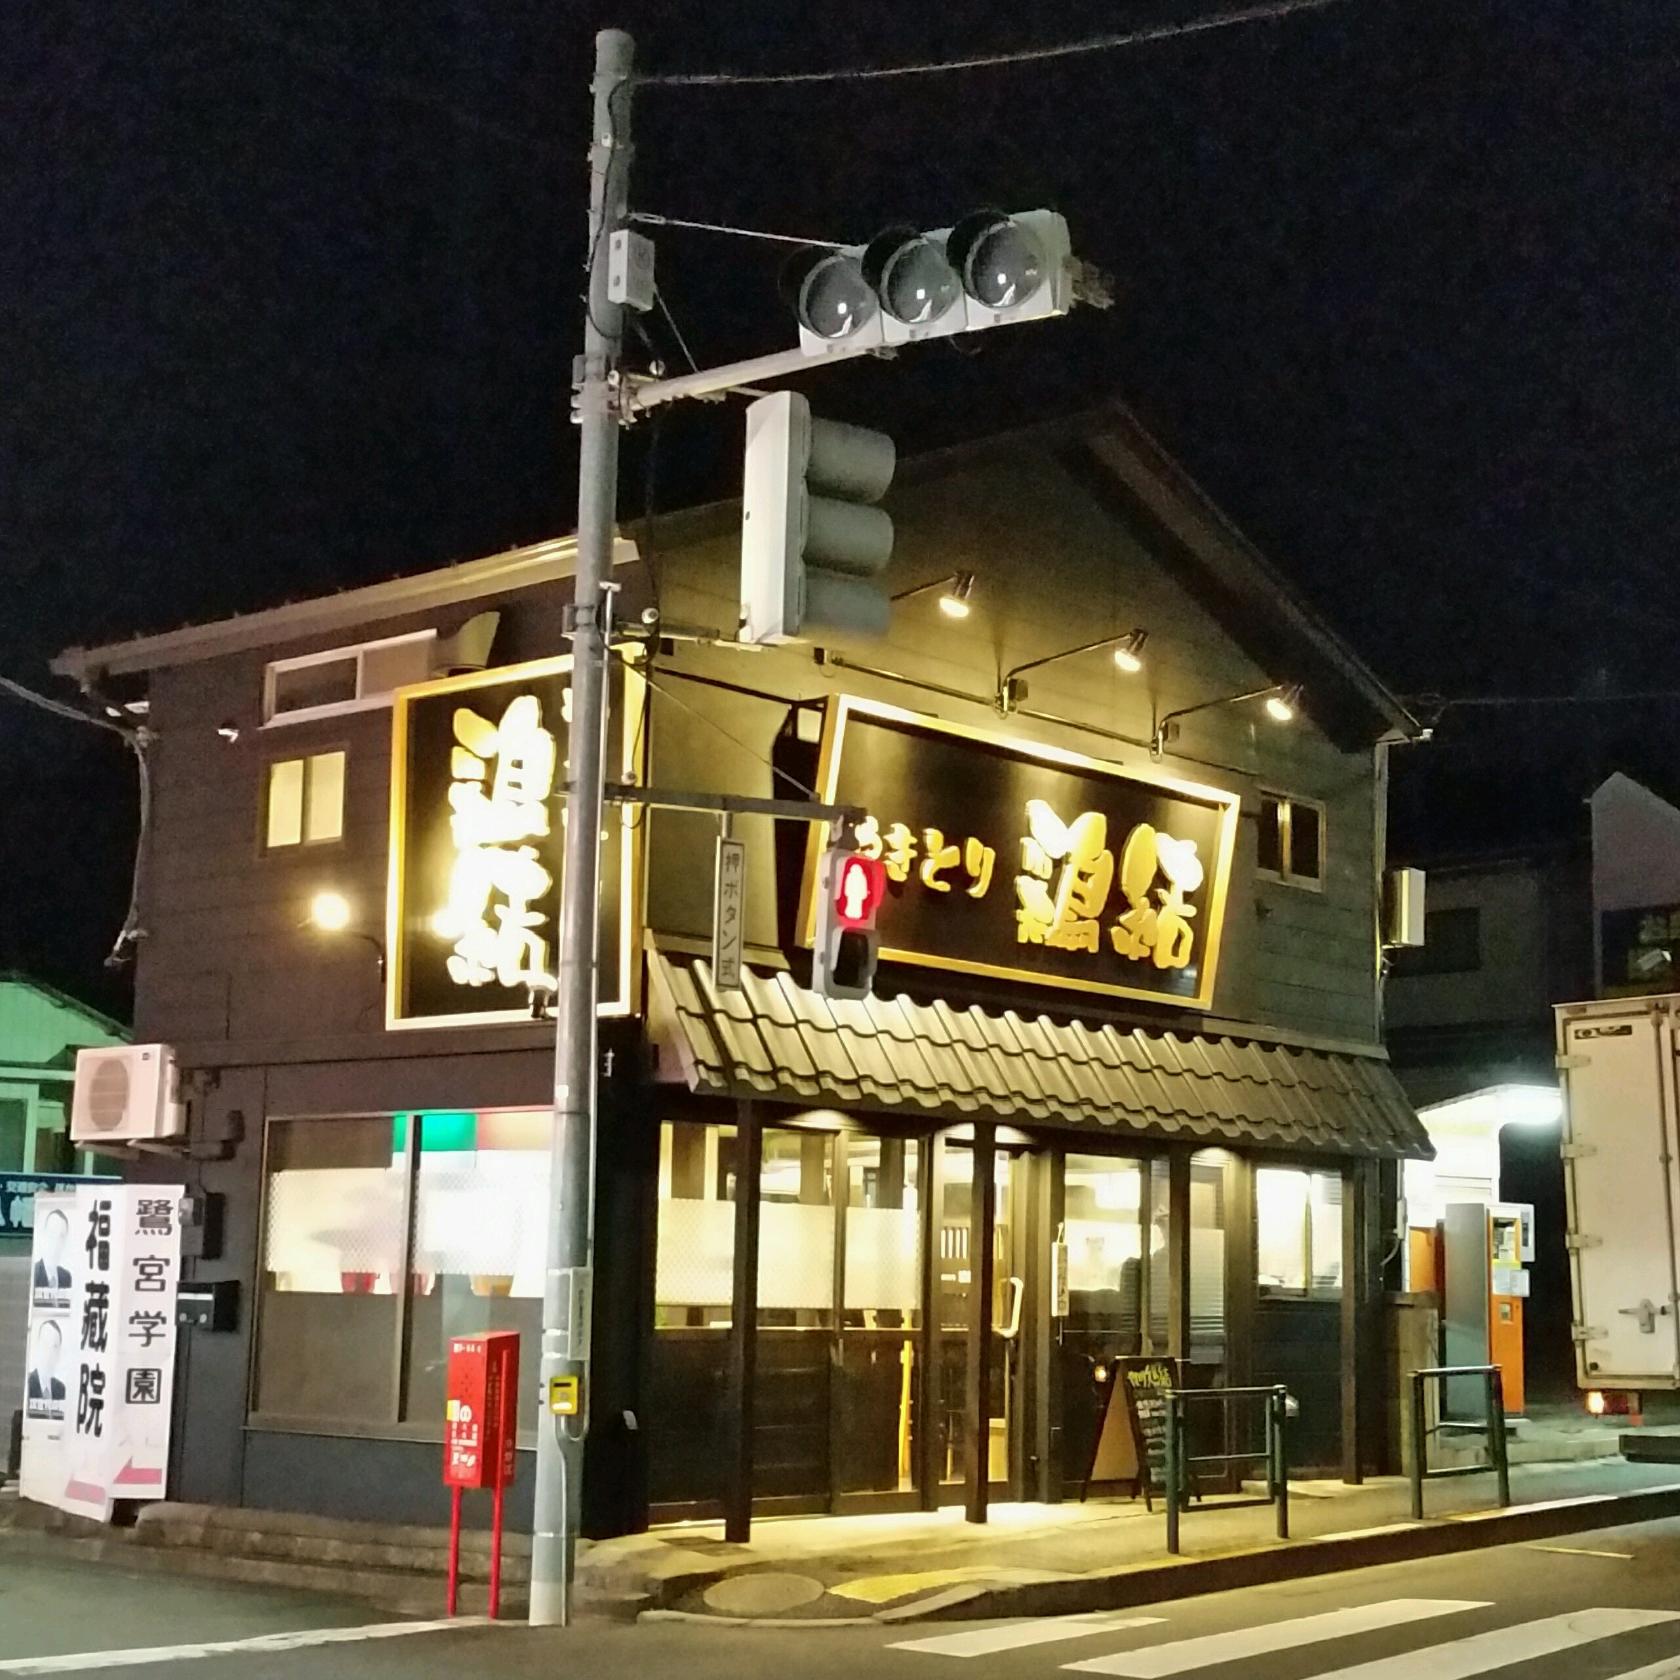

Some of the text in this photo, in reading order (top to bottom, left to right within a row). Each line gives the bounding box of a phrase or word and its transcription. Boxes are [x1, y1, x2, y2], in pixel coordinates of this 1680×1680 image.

[720, 852, 741, 978] 押ボタン式
[125, 1199, 174, 1404] 鷺宮学園
